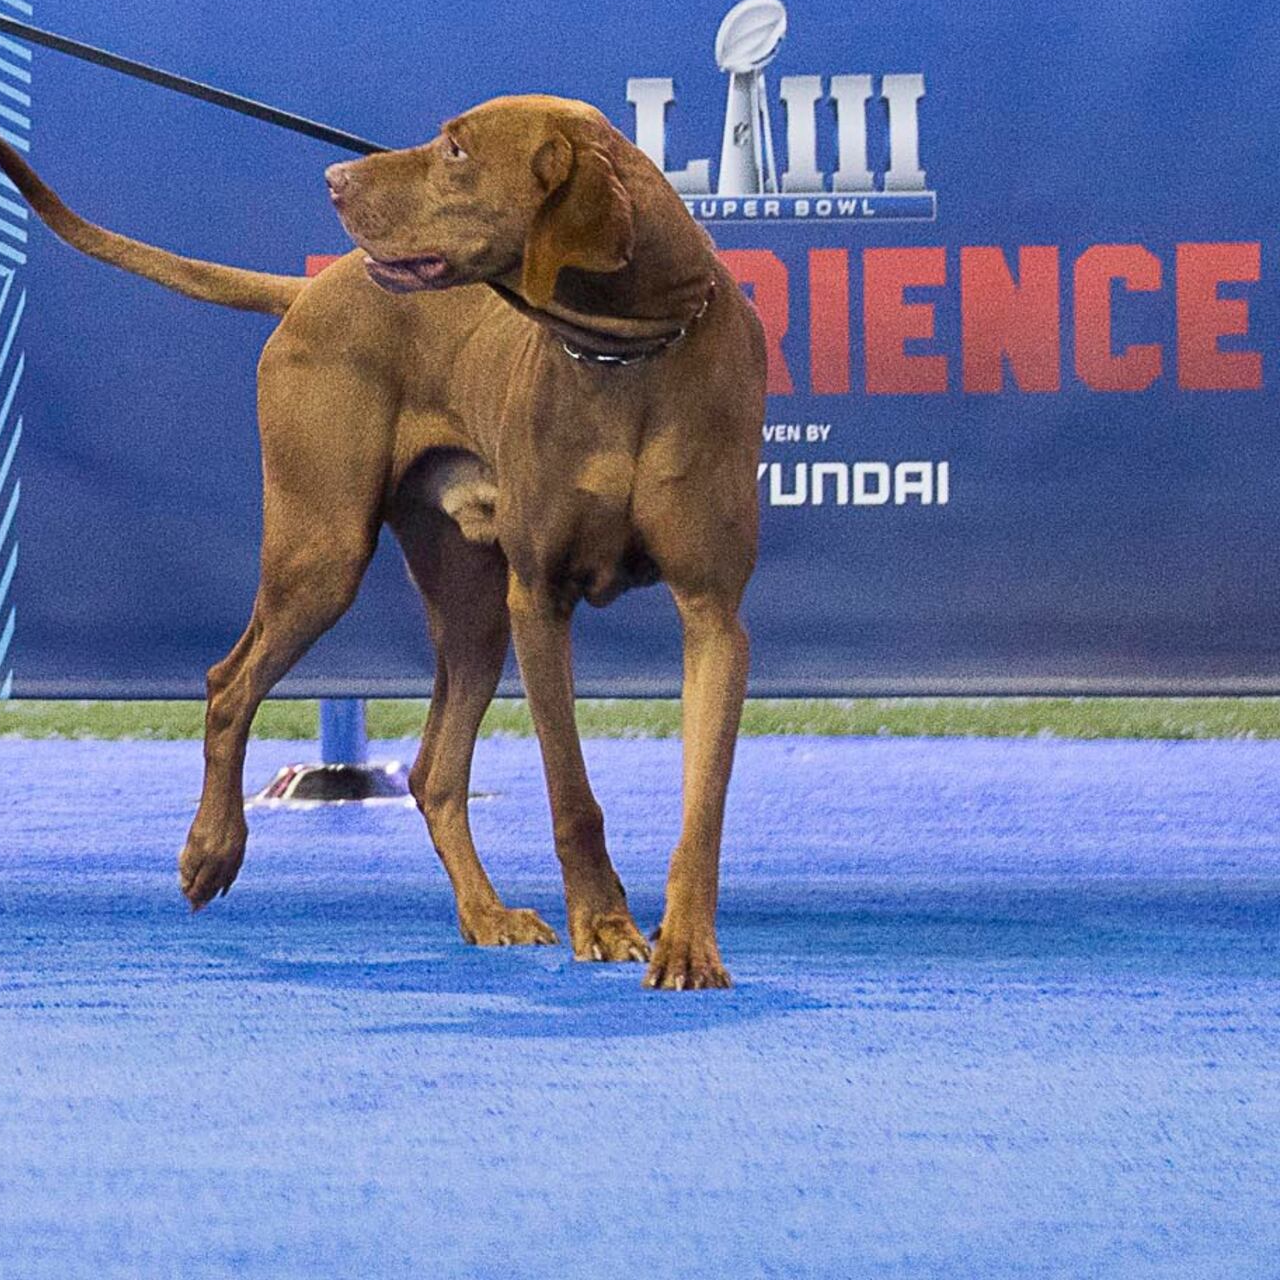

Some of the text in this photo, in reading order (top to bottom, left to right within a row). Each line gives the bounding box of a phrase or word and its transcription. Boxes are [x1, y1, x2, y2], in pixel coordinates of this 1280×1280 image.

[794, 199, 876, 216] BOWL
[806, 424, 832, 442] BY
[756, 461, 950, 506] UNDAI
